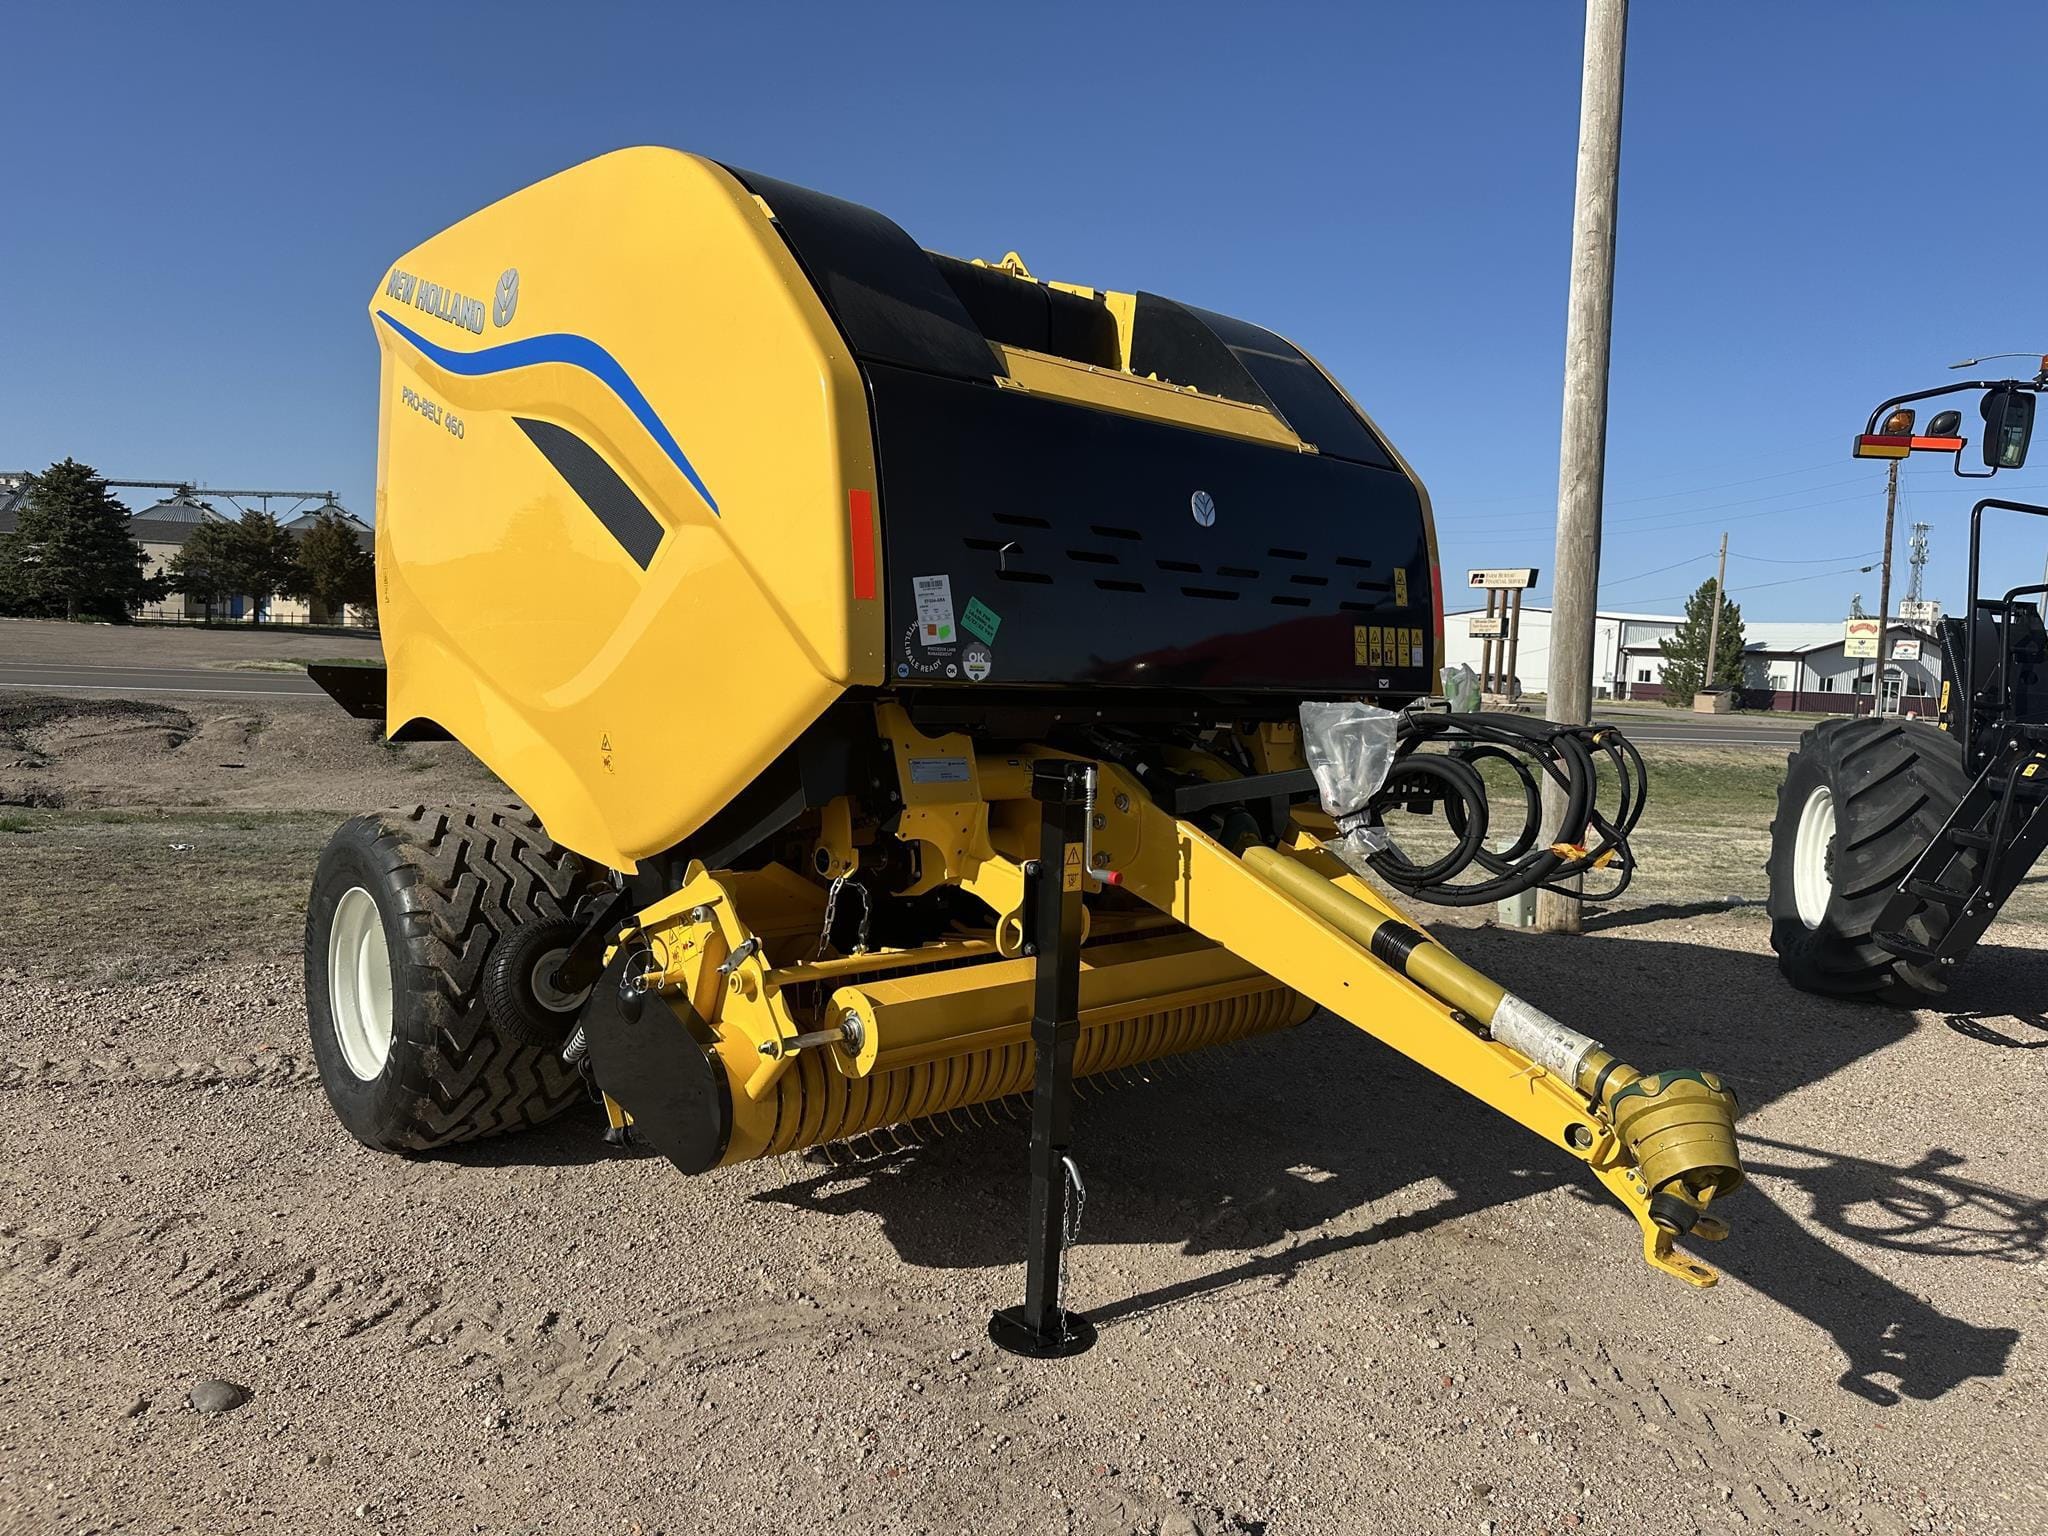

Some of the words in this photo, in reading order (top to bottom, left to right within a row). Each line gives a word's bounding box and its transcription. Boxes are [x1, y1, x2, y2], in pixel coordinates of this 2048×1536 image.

[386, 268, 418, 305] NEW
[415, 279, 485, 335] HOLLAND
[402, 385, 443, 426] PRO-BELT
[445, 412, 464, 440] 460
[920, 658, 942, 673] READY
[968, 652, 985, 663] OK
